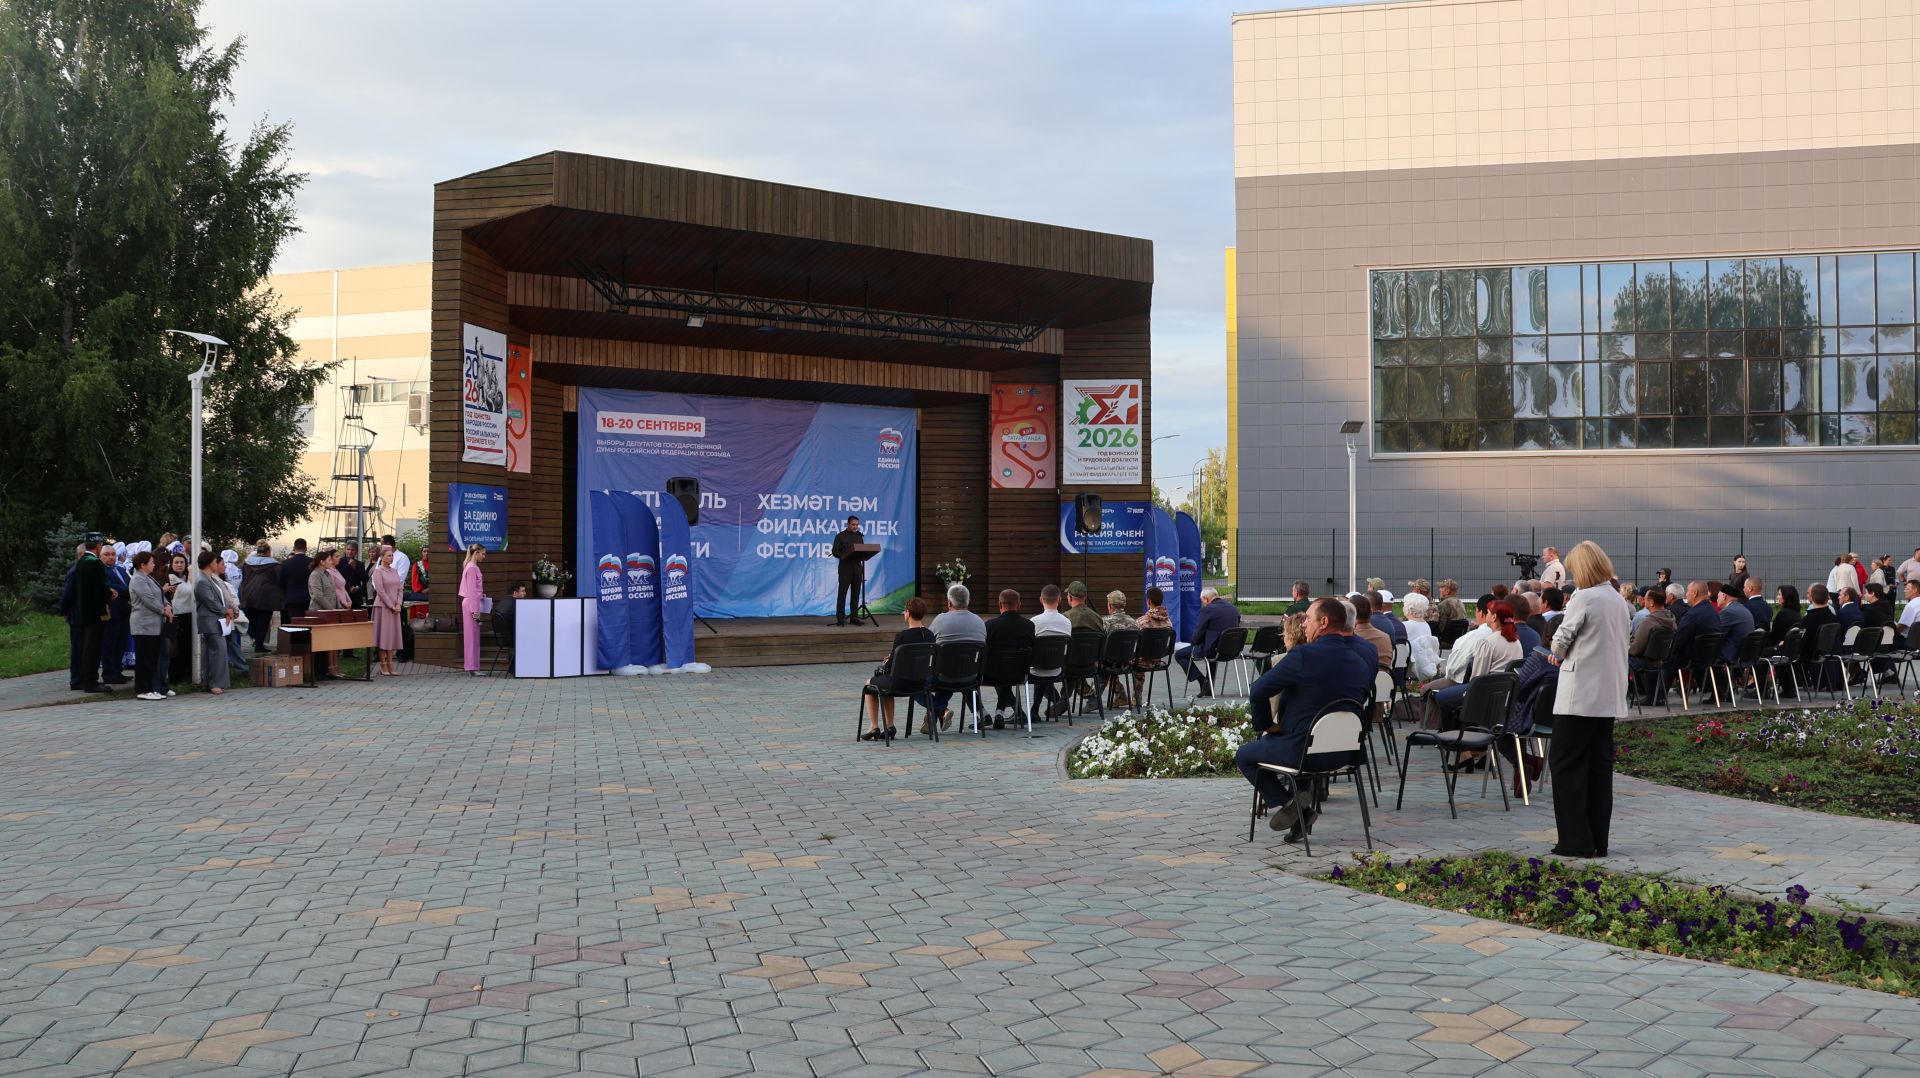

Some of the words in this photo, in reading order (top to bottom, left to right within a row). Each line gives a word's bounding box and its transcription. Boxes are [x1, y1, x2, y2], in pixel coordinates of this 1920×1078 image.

[465, 356, 478, 379] 20
[465, 378, 478, 403] 26
[601, 417, 634, 429] 18-20
[636, 419, 702, 433] СЕНТЯБРЯ
[1077, 427, 1139, 448] 2026
[596, 446, 616, 454] ДУМЫ
[617, 447, 660, 455] РОССИЙСКОЙ
[663, 442, 721, 450] ГОСУДАРСТВЕННОЙ
[757, 494, 833, 510] ХЕЗМӘТ
[838, 496, 877, 511] ҺӘМ
[464, 511, 472, 520] ЗА
[472, 511, 497, 522] ЕДИНУЮ
[464, 522, 490, 531] РОССИЮ!
[1115, 530, 1144, 538] ӨЧЕН!
[602, 594, 622, 602] РОССИЯ
[666, 592, 687, 601] РОССИЯ
